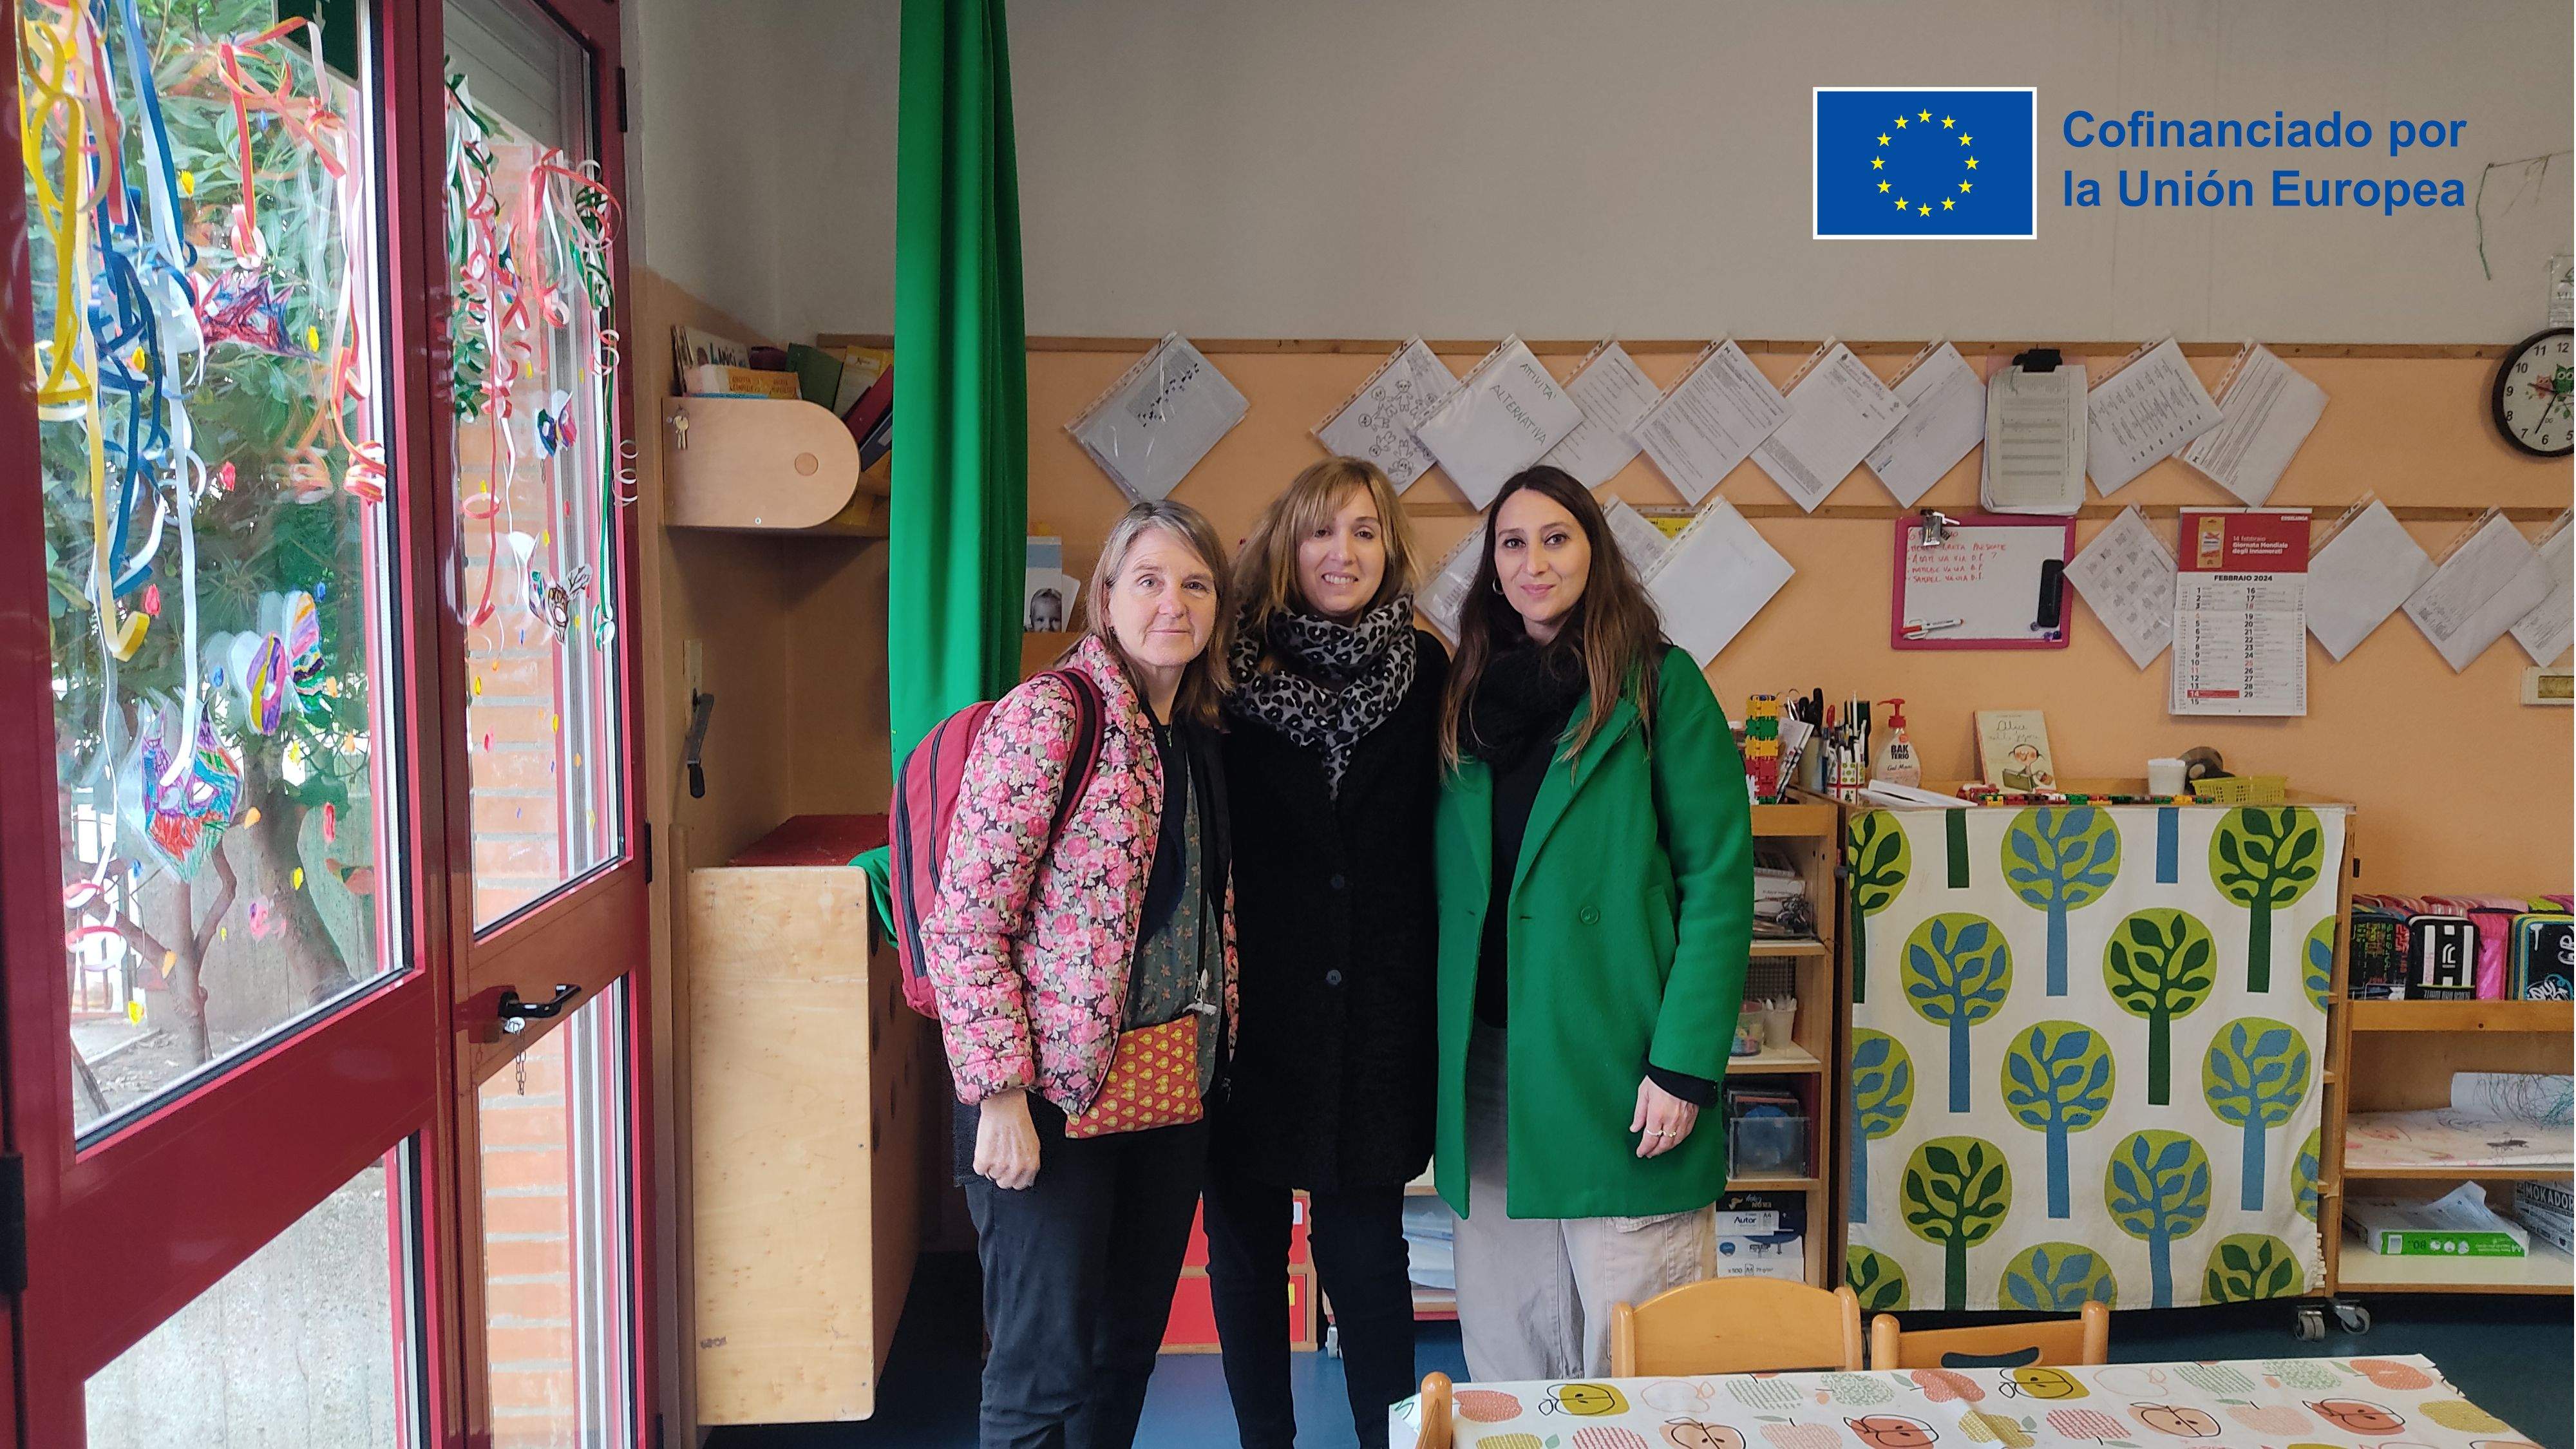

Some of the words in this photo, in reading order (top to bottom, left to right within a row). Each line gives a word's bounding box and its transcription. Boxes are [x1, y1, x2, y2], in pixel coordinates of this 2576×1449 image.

[2534, 345, 2546, 356] 11
[2557, 343, 2570, 353] 12
[2515, 363, 2528, 373] 10
[2506, 386, 2514, 397] 9
[1490, 384, 1547, 446] ALTERNATIVA
[2506, 411, 2513, 421] 8
[2521, 428, 2528, 439] 7
[2566, 430, 2573, 440] 5
[2541, 435, 2549, 445] 6
[1891, 744, 1909, 753] BAK
